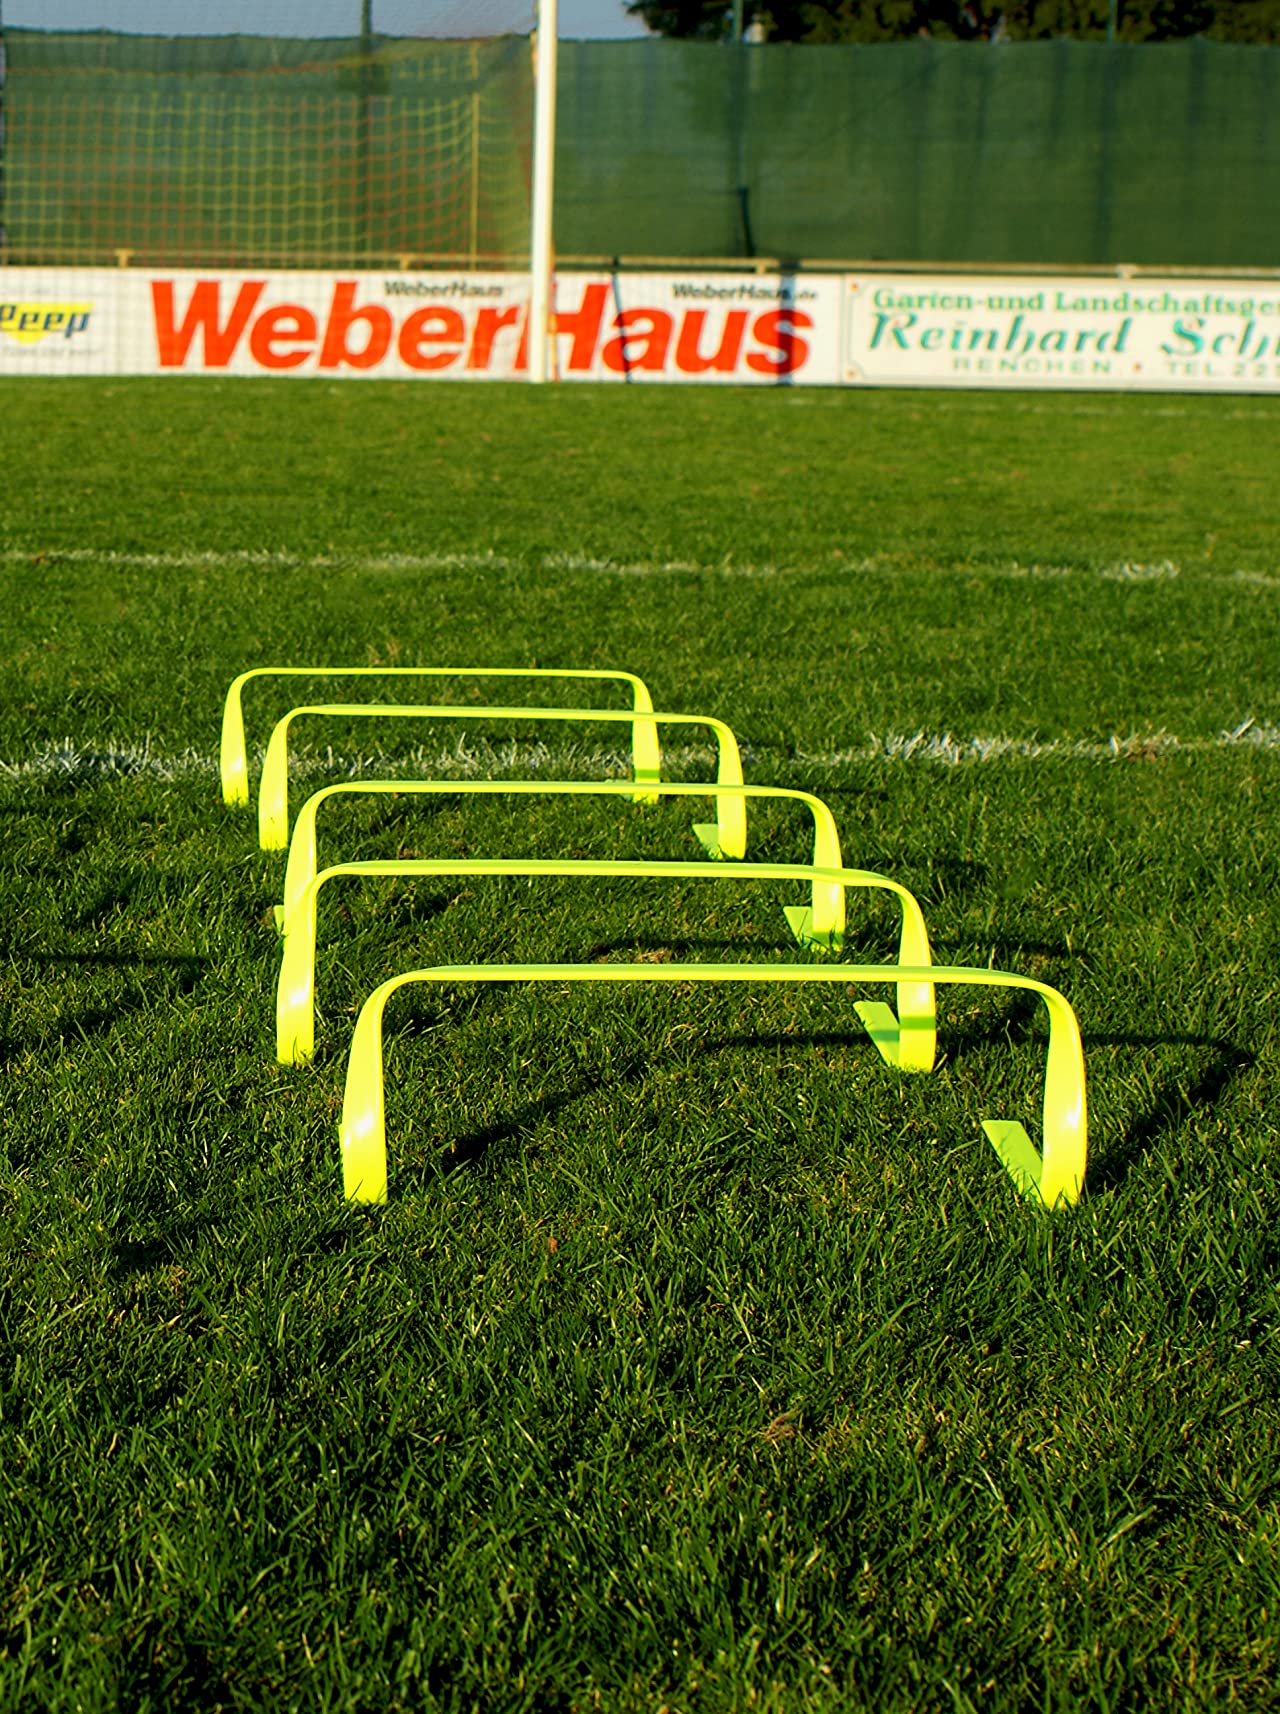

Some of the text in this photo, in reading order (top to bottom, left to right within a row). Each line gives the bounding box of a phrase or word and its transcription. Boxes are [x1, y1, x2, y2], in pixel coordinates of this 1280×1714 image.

[384, 281, 503, 297] WeberHaus
[150, 280, 815, 375] WeberHaus
[869, 312, 1280, 361] Reinhard Sch
[953, 357, 1113, 374] RENCHEN
